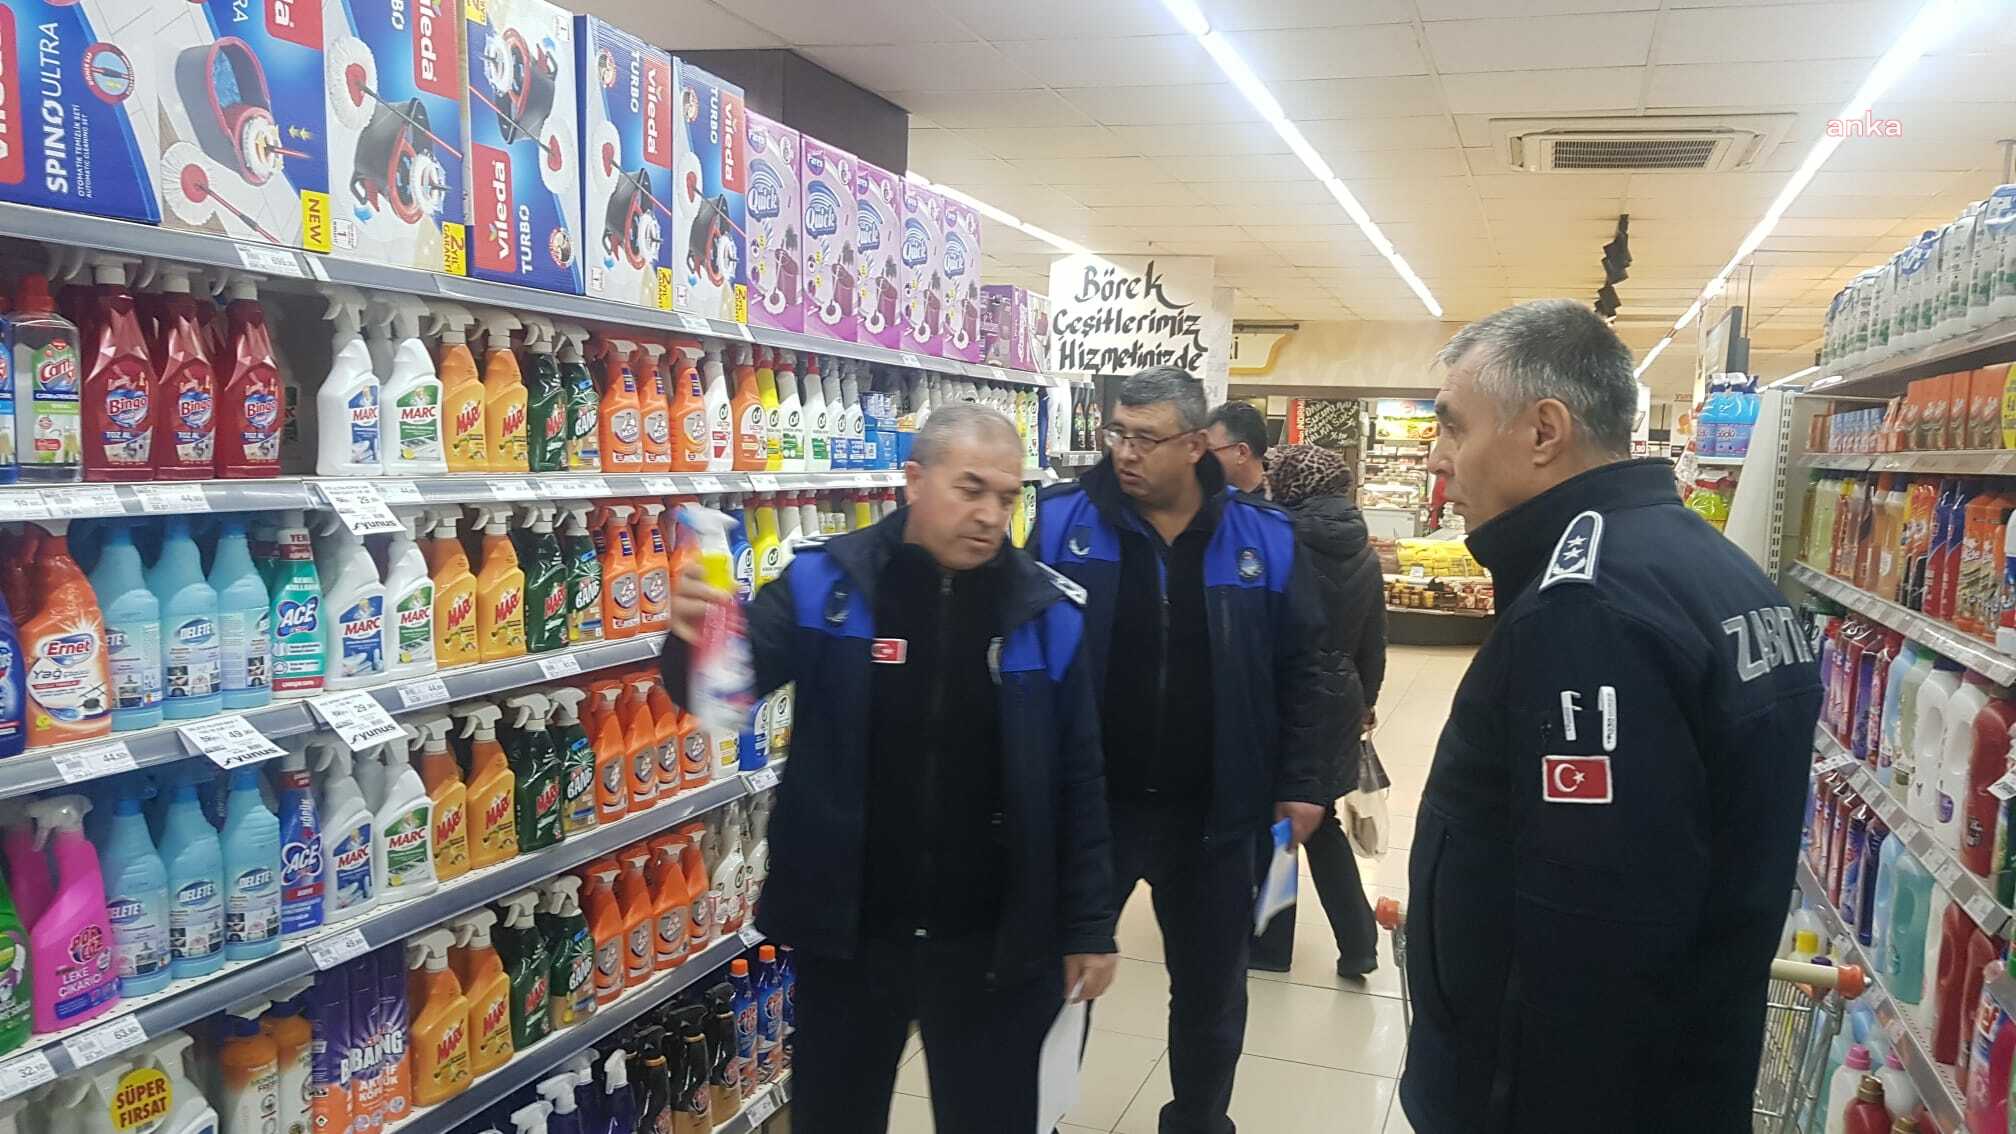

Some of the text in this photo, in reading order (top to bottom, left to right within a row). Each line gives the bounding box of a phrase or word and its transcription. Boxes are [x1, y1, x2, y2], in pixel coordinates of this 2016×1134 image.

[491, 160, 510, 260] vileda
[805, 204, 836, 231] Quick
[308, 198, 322, 244] NEW
[517, 204, 533, 274] TURBO
[858, 221, 880, 246] uick
[1074, 260, 1194, 309] Börek
[353, 407, 378, 421] MARC
[401, 407, 436, 420] MARC
[361, 520, 397, 530] yunus
[280, 602, 316, 628] ACE
[400, 606, 430, 624] MARC
[179, 622, 213, 640] DELETE
[344, 617, 381, 636] MARC
[47, 640, 91, 656] Ernet
[360, 723, 396, 741] yunus
[233, 748, 278, 763] yunus
[389, 827, 426, 848] MARC
[288, 844, 319, 873] ACE
[338, 844, 369, 869] MARC
[239, 870, 273, 886] DELETE
[178, 884, 215, 901] DELETE
[111, 904, 141, 919] ELETE
[116, 1077, 167, 1110] SÜPER
[119, 1097, 168, 1129] FIRSAT
